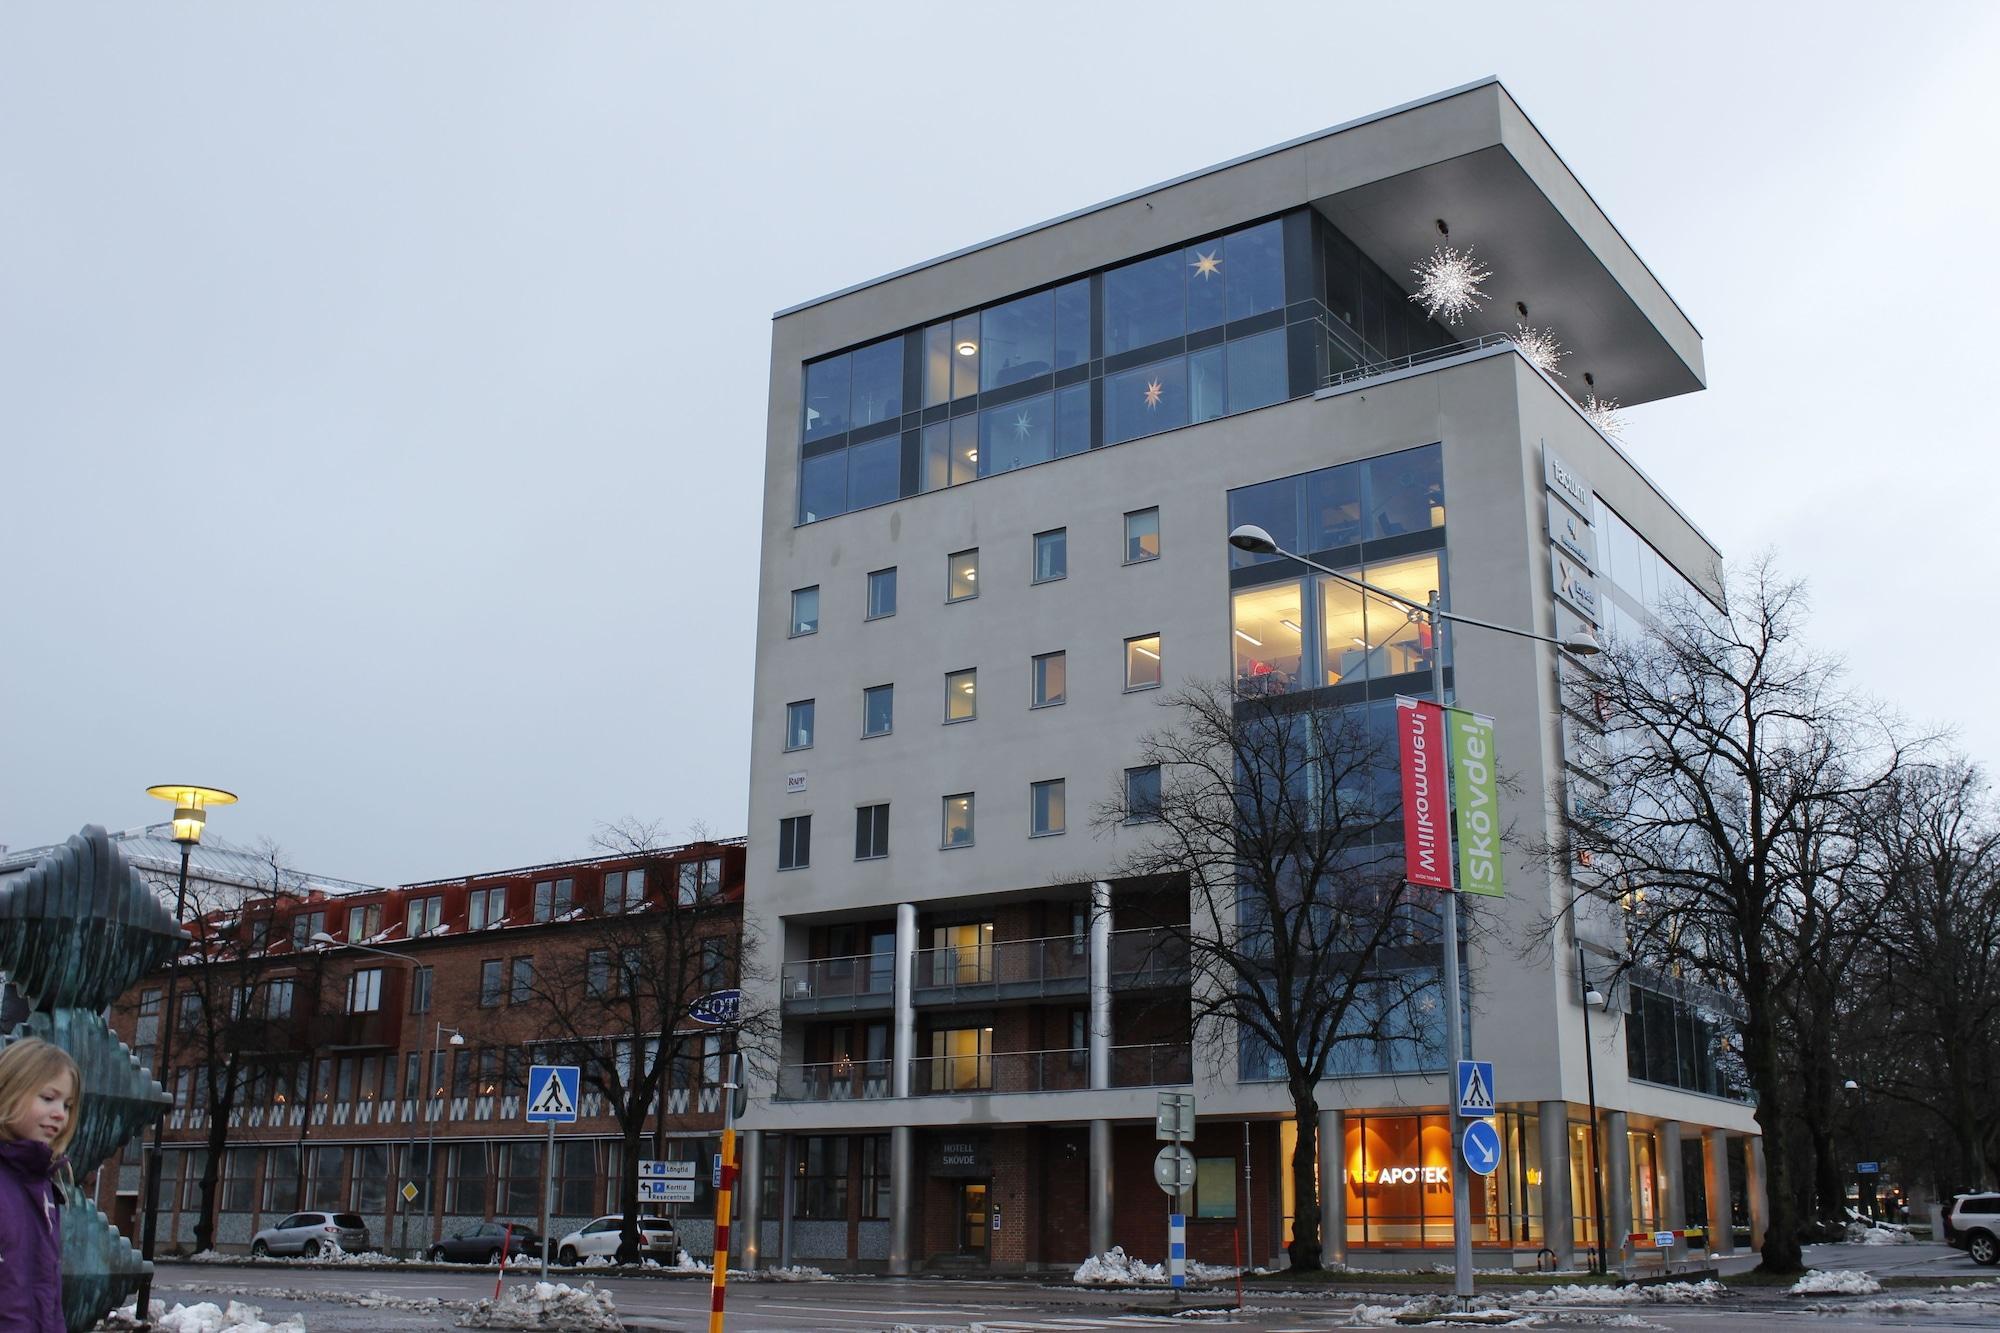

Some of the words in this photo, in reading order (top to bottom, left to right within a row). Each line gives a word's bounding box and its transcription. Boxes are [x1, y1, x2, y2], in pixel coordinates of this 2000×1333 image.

[1553, 459, 1587, 505] factum
[1461, 723, 1495, 883] Skövde!
[696, 997, 741, 1016] HOT
[943, 1143, 974, 1152] HOTELL
[1378, 1167, 1449, 1185] APOTEK
